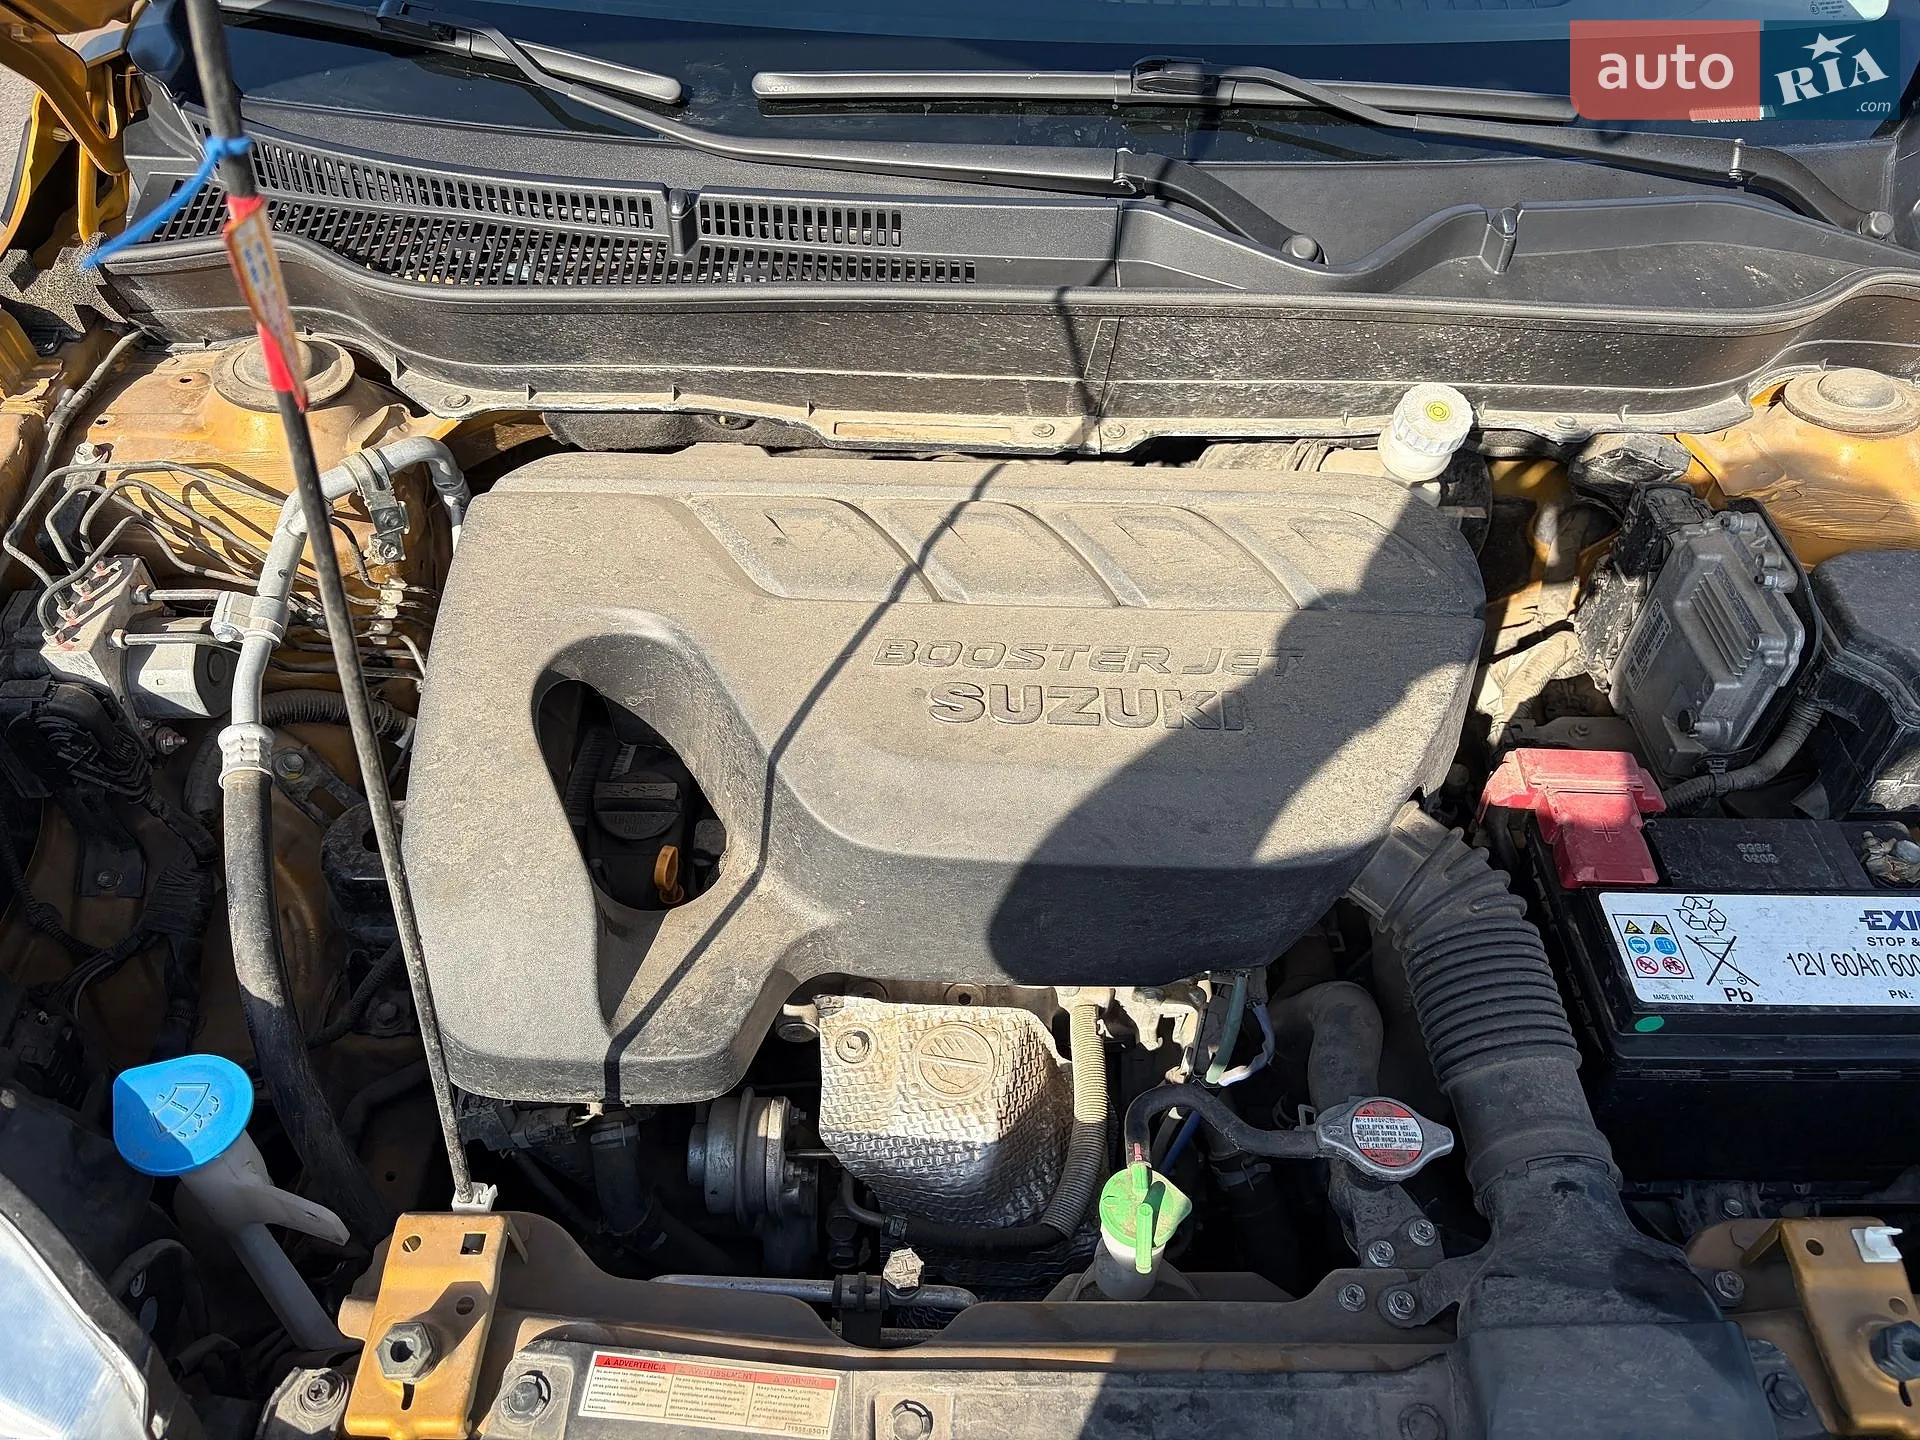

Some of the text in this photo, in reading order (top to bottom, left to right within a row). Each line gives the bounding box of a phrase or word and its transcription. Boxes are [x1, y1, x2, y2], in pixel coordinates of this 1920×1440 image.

[873, 639, 1305, 677] BOOSTER JET
[928, 682, 1244, 730] SUZUKI
[1859, 910, 1920, 931] EXI
[1867, 937, 1905, 946] STOP
[1787, 953, 1826, 976] 12V
[1831, 953, 1887, 976] 60Ah
[1723, 988, 1753, 1002] Pb
[1888, 990, 1914, 999] PN:
[613, 1359, 666, 1371] ADVERTENCIA
[783, 1376, 820, 1386] WARNING
